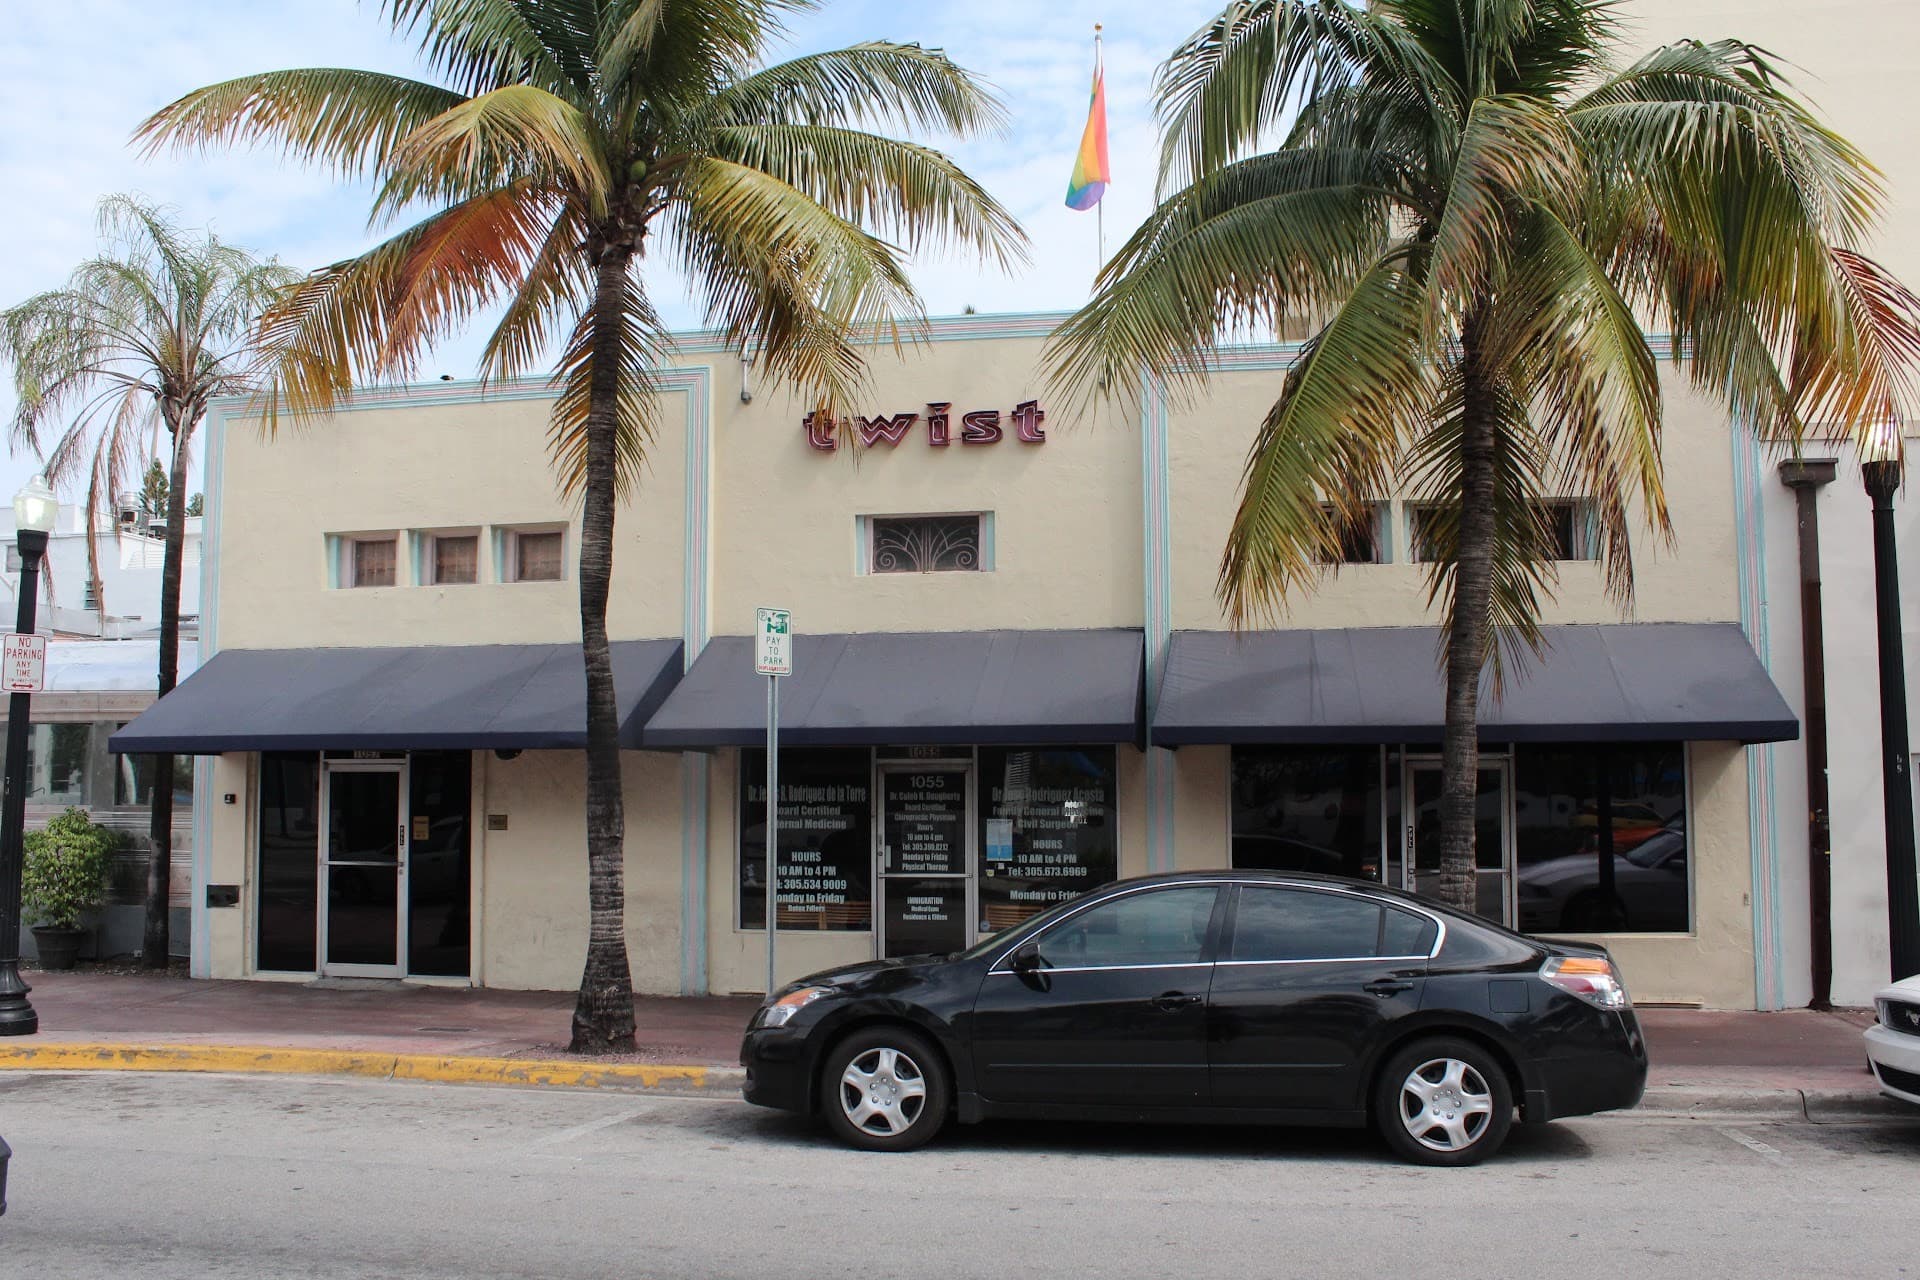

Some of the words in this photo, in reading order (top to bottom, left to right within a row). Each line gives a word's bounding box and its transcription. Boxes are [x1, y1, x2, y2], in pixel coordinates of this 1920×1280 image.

[802, 399, 1046, 449] twist
[18, 637, 32, 647] NO
[766, 636, 781, 645] PAY
[6, 647, 42, 660] PARKING
[768, 646, 779, 655] TO
[16, 660, 31, 668] ANY
[763, 656, 783, 665] PARK
[16, 669, 31, 677] TIME
[910, 775, 945, 789] 1055
[788, 784, 826, 804] Rodriguez
[827, 784, 836, 802] de
[837, 784, 845, 802] la
[845, 784, 866, 802] Torre
[1026, 786, 1071, 804] Rodriguez
[1072, 786, 1104, 802] Acosta
[777, 805, 799, 815] oard
[800, 805, 841, 815] Certified
[1023, 806, 1060, 816] General
[804, 819, 847, 829] Medicine
[1017, 818, 1038, 829] Civil
[1039, 818, 1078, 830] Surgeon
[1032, 839, 1063, 849] HOURS
[791, 851, 822, 862] HOURS
[902, 853, 924, 862] Monday
[924, 853, 930, 861] to
[931, 853, 949, 862] Friday
[1017, 854, 1029, 863] 10
[1030, 854, 1044, 863] AM
[1045, 854, 1054, 863] to
[1055, 854, 1062, 863] 4
[1063, 854, 1077, 863] PM
[778, 865, 788, 875] 10
[788, 865, 803, 875] AM
[804, 865, 814, 875] to
[815, 865, 822, 875] 4
[822, 865, 837, 876] PM
[902, 863, 926, 872] Physical
[926, 863, 949, 872] Therapy
[1008, 867, 1024, 877] Tel:
[777, 892, 805, 904] onday
[805, 893, 815, 903] to
[816, 892, 846, 904] Friday
[907, 896, 944, 905] IMMIGRATION
[1010, 890, 1047, 901] Monday
[1047, 890, 1057, 900] to
